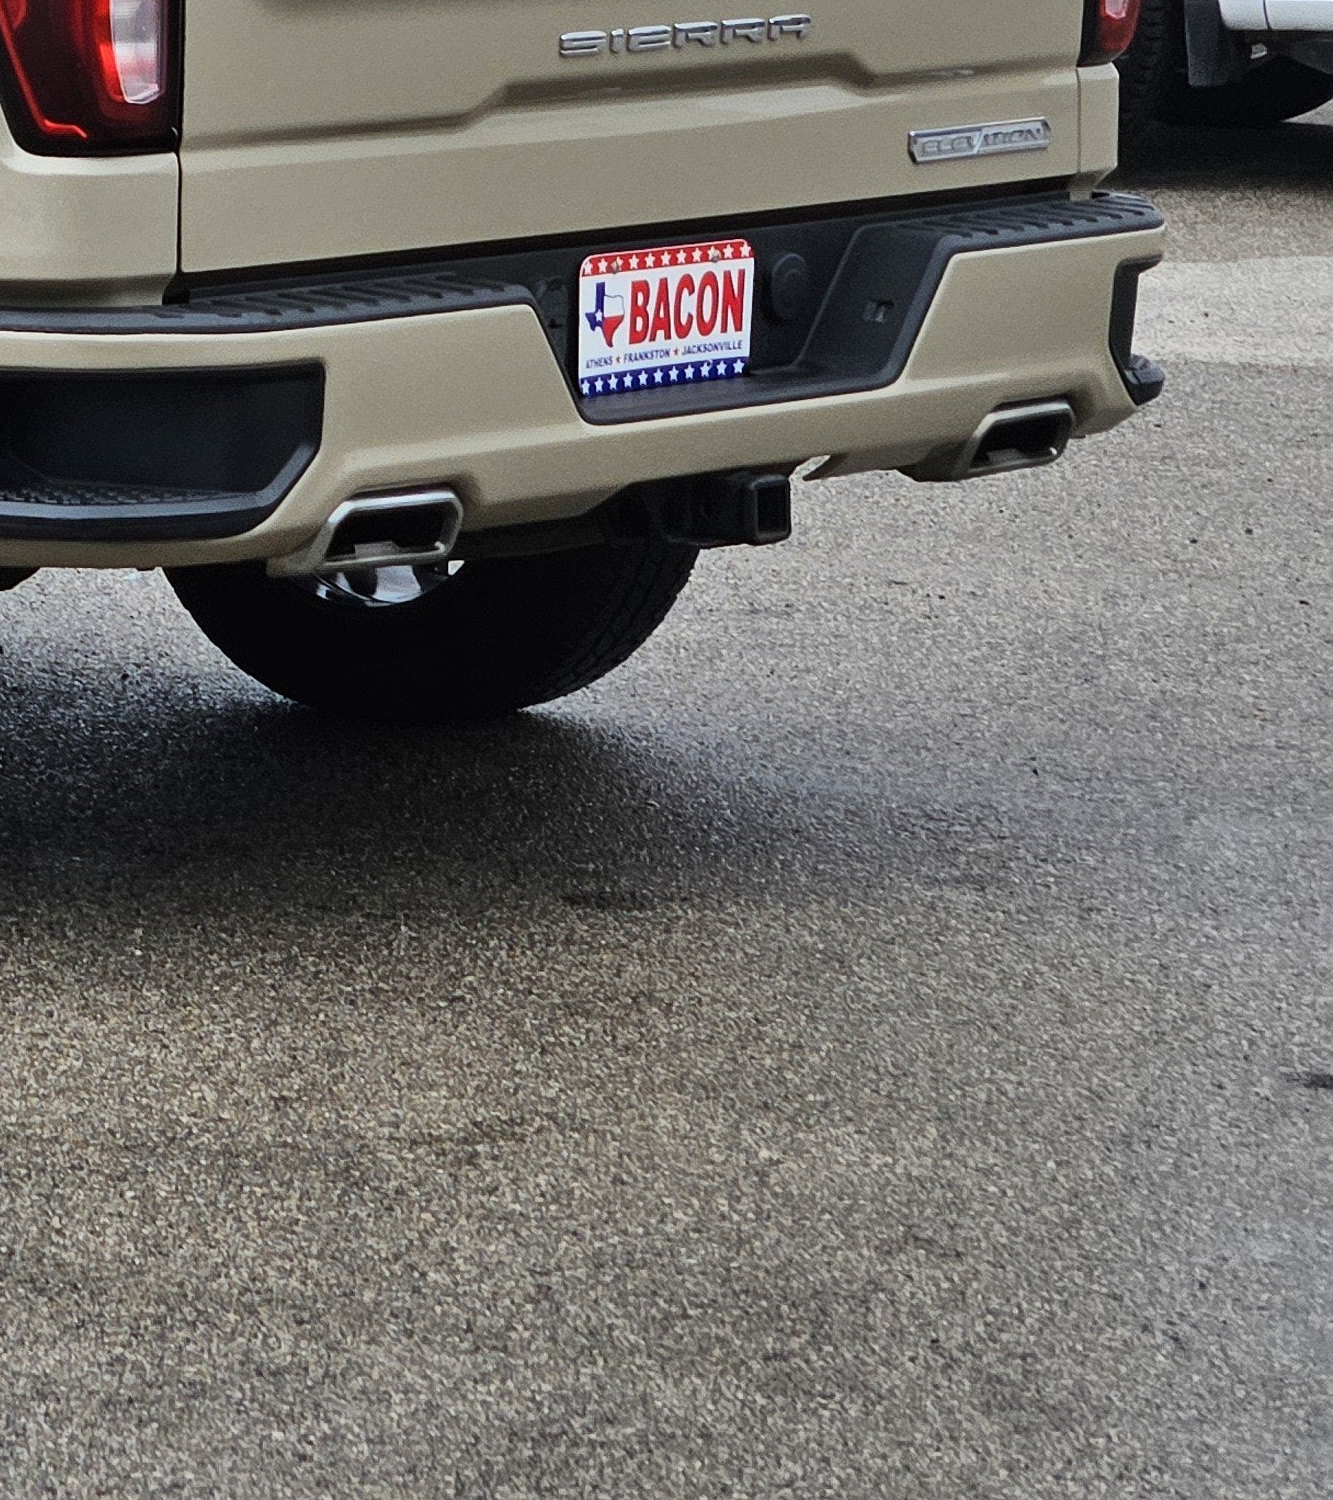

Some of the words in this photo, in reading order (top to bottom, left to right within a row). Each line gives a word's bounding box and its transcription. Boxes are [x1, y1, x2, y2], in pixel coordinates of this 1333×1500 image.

[560, 13, 812, 58] SIERRA
[628, 268, 746, 344] BACON
[585, 354, 613, 369] ATHENS
[623, 348, 671, 364] FRANKSTON
[681, 339, 744, 356] JACKSONVILLE
